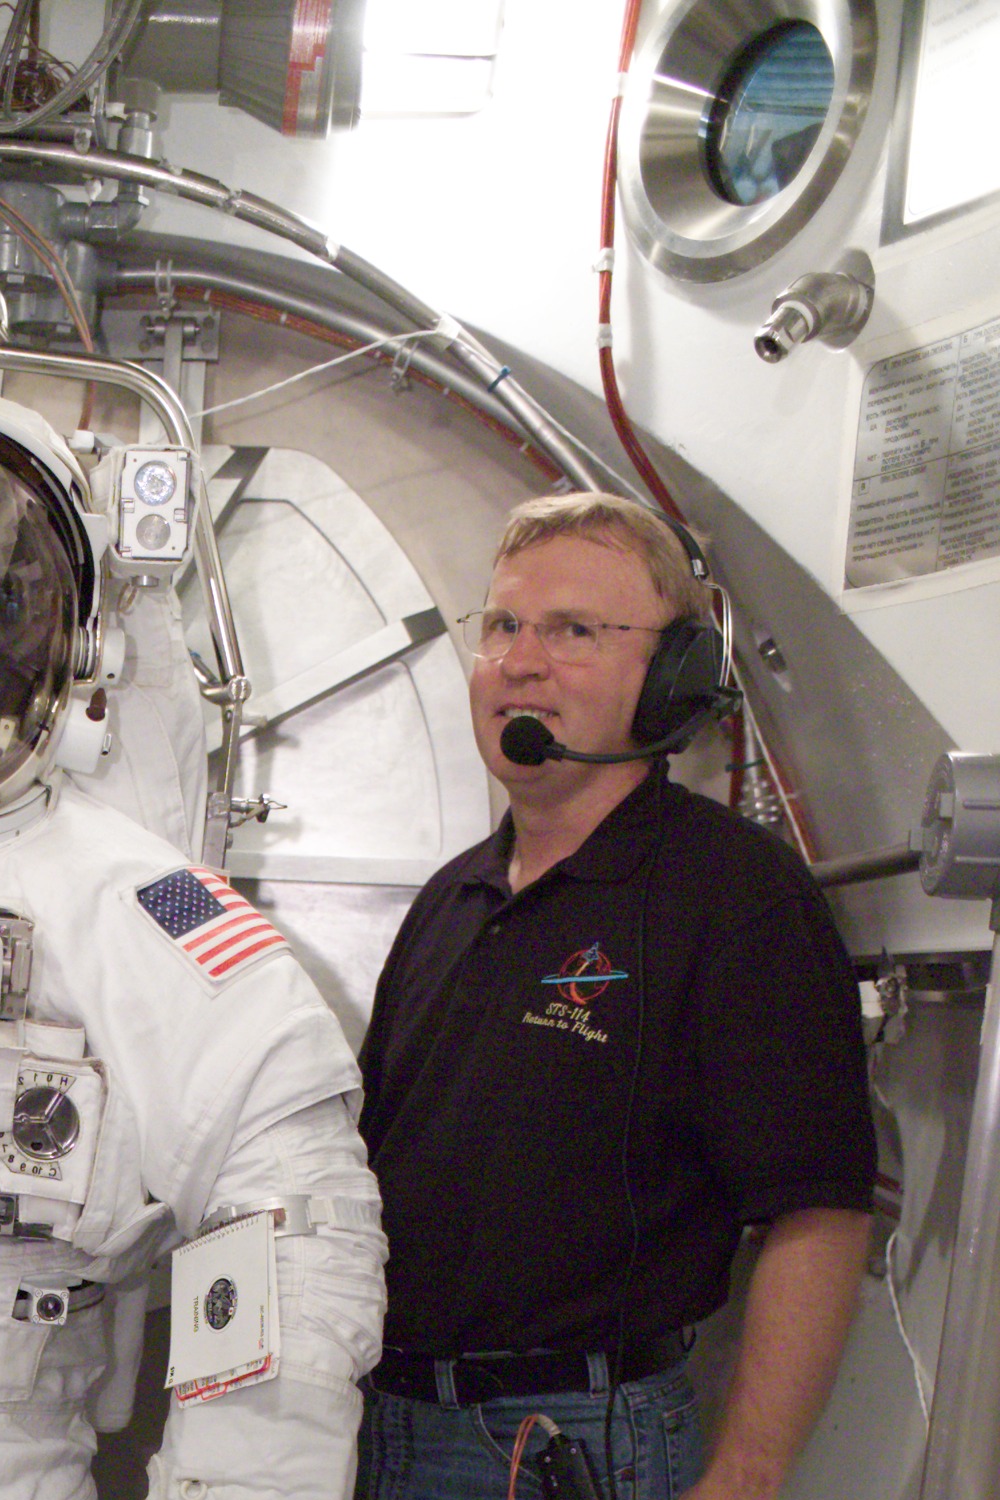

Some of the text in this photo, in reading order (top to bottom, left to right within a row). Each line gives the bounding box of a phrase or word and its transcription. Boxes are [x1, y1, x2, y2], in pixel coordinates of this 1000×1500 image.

[545, 1002, 591, 1023] STS-114
[522, 1011, 608, 1043] Return to Flight
